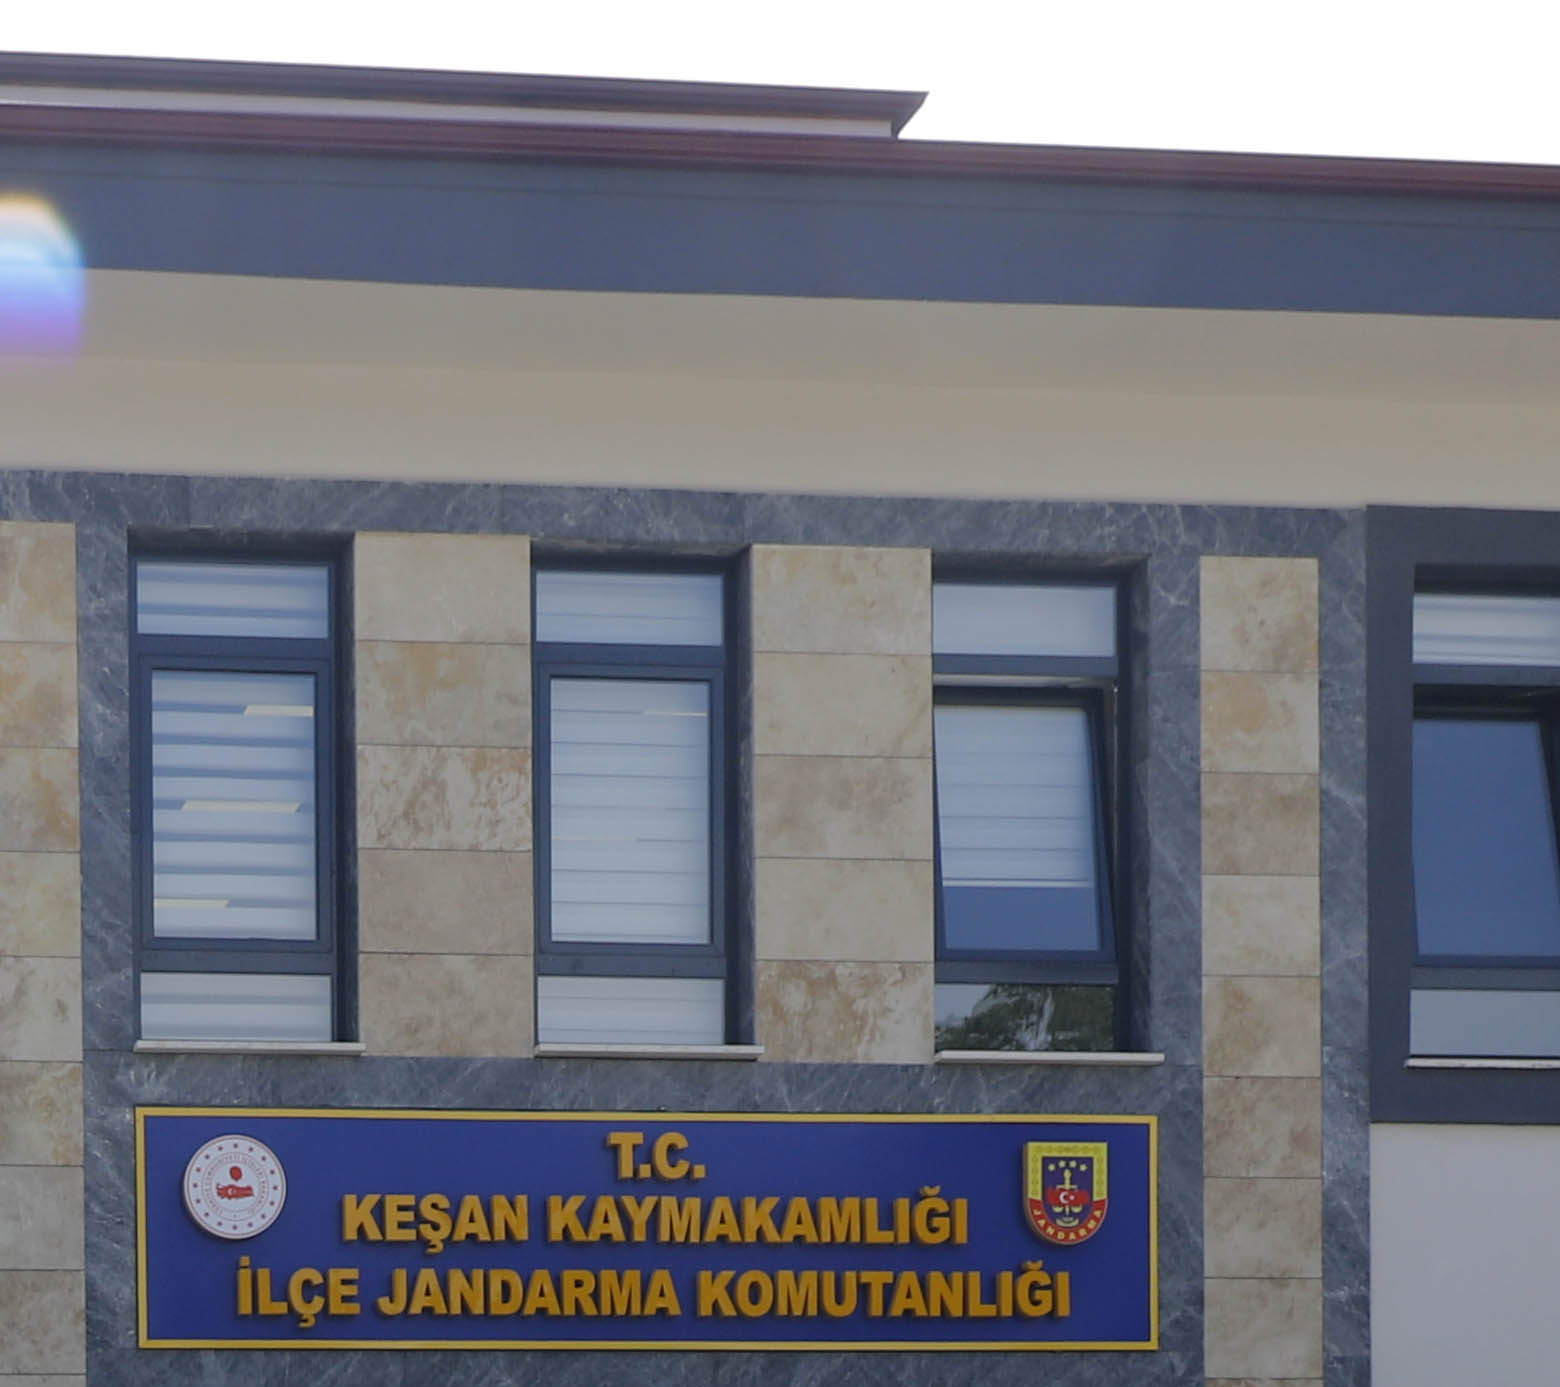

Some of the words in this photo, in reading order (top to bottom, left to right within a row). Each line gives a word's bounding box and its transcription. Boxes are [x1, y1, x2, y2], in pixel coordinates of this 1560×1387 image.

[607, 1131, 707, 1180] T.C.
[342, 1193, 530, 1254] KEŞAN
[546, 1185, 969, 1245] KAYMAKAMLIĞI
[1033, 1208, 1103, 1241] JANDARMA
[236, 1255, 361, 1328] İLÇE
[377, 1267, 682, 1317] JANDARMA
[696, 1260, 1071, 1318] KOMUTANLIĞI
